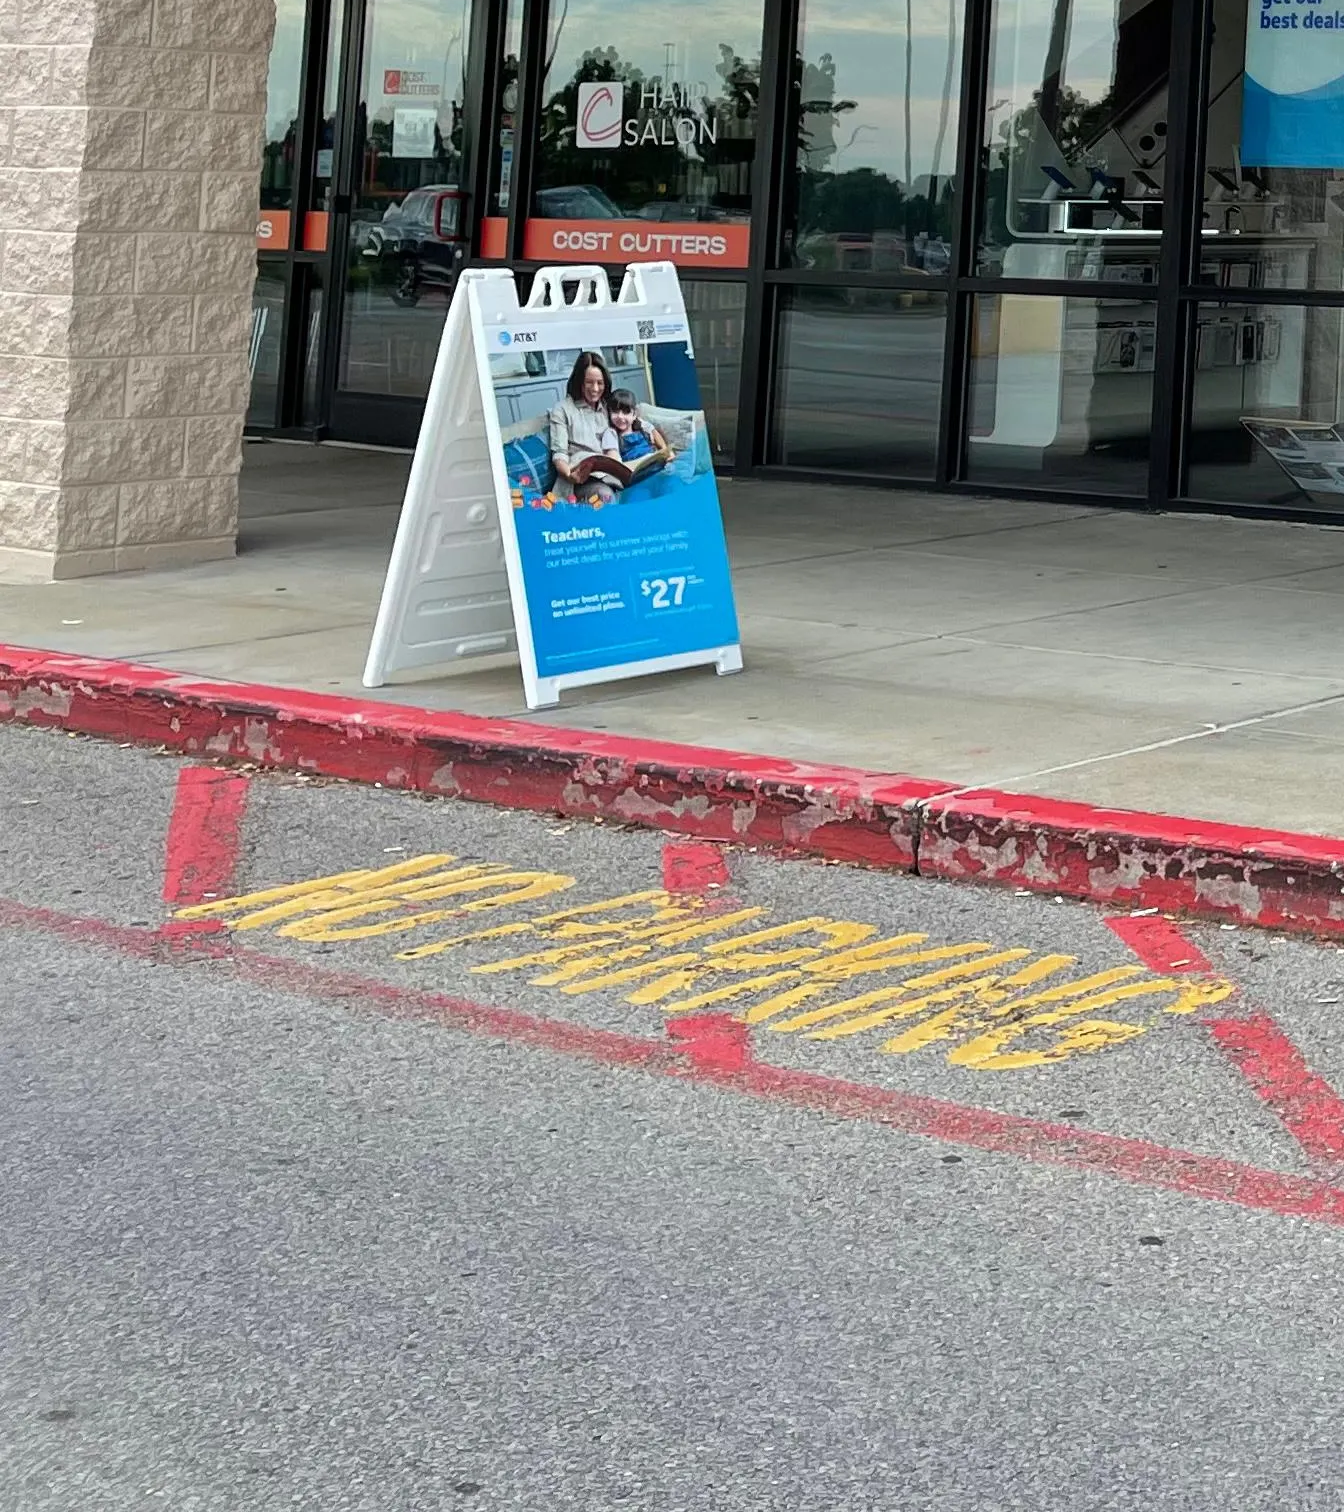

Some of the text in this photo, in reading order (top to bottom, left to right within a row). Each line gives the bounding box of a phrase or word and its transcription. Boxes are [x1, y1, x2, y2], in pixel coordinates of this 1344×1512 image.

[1260, 10, 1299, 29] best
[640, 81, 709, 109] HAIR
[624, 117, 718, 146] SALON
[553, 231, 727, 255] COST CUTTERS
[513, 332, 538, 343] AT&T
[542, 526, 606, 544] Teachers,
[561, 555, 579, 566] best
[641, 575, 686, 610] $27
[168, 854, 577, 943] NO
[397, 889, 1235, 1071] PARKING
